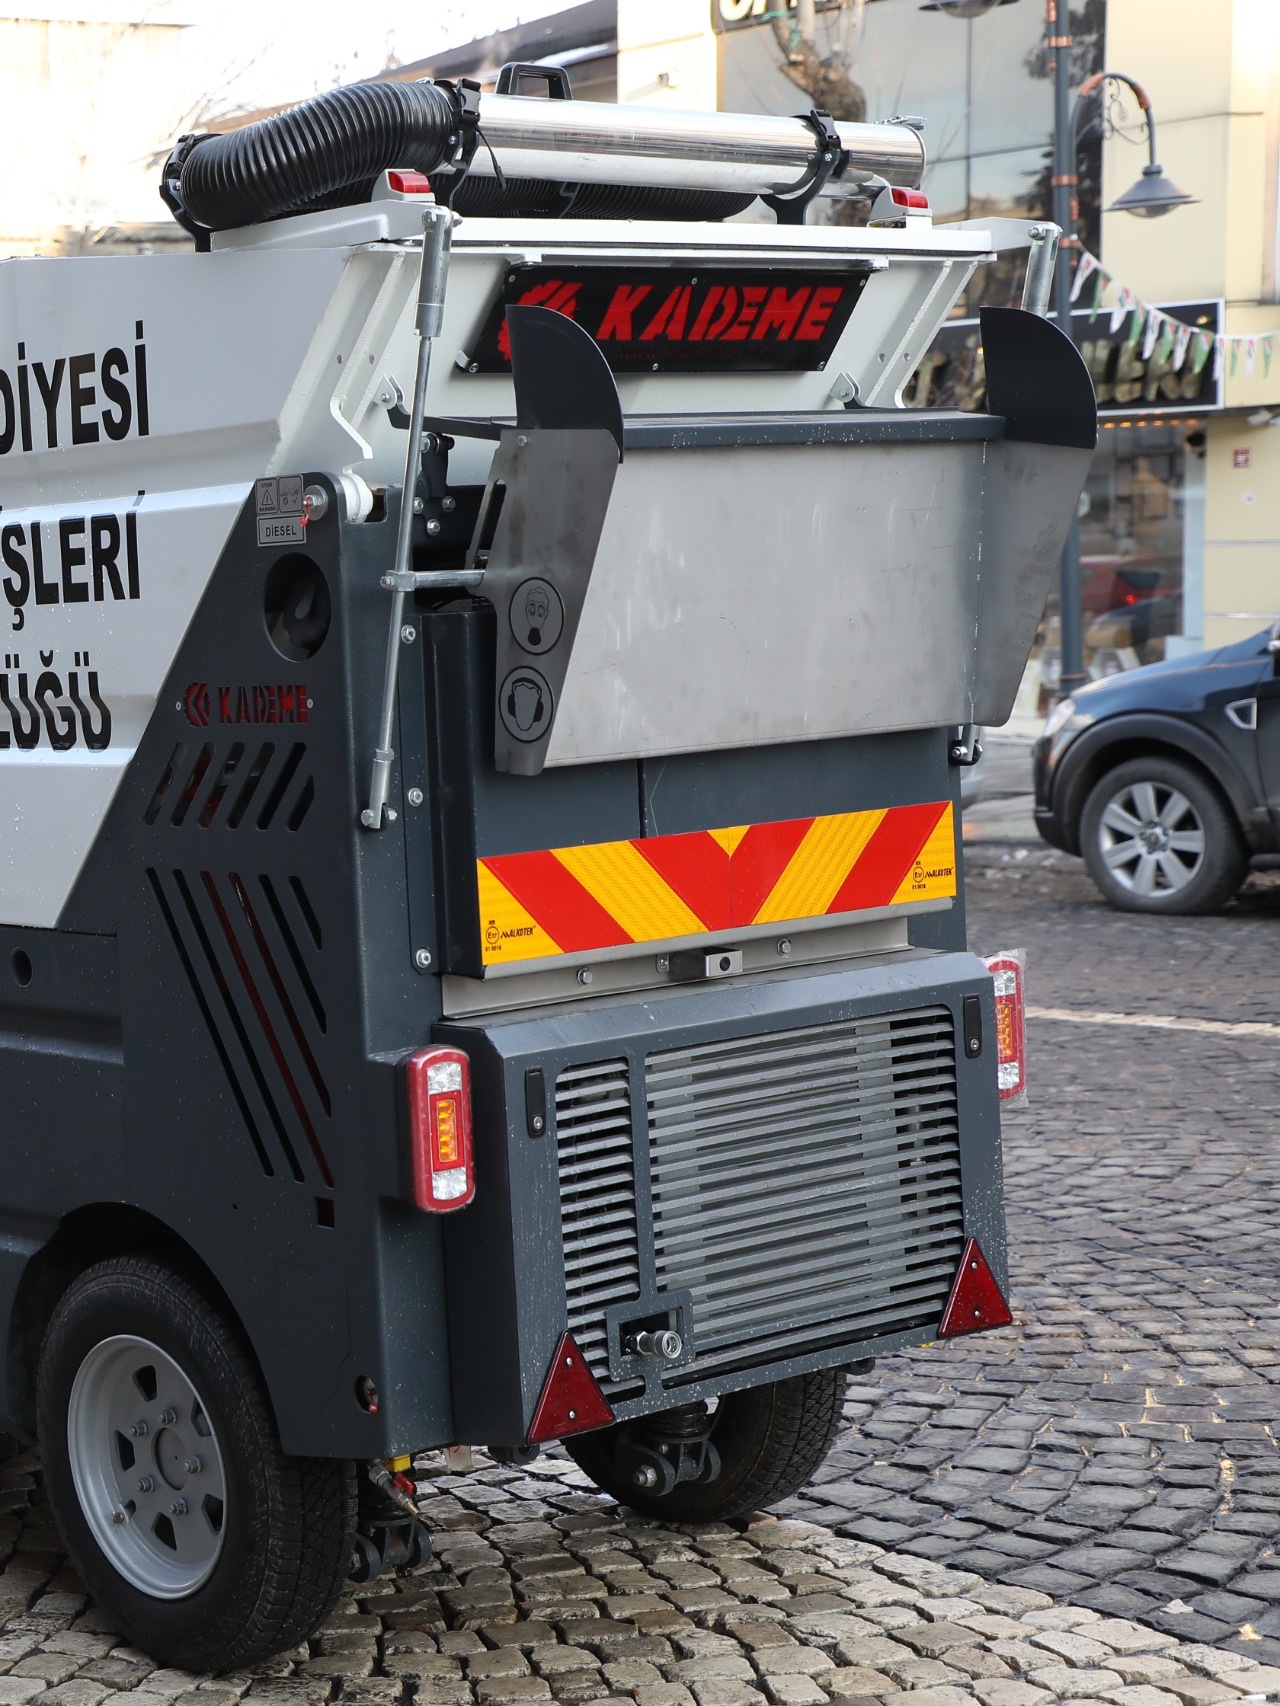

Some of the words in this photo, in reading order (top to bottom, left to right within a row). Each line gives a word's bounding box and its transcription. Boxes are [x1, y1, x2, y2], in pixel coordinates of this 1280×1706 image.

[596, 285, 845, 342] KADEME
[265, 525, 296, 537] DİESEL
[217, 684, 309, 724] KADEME
